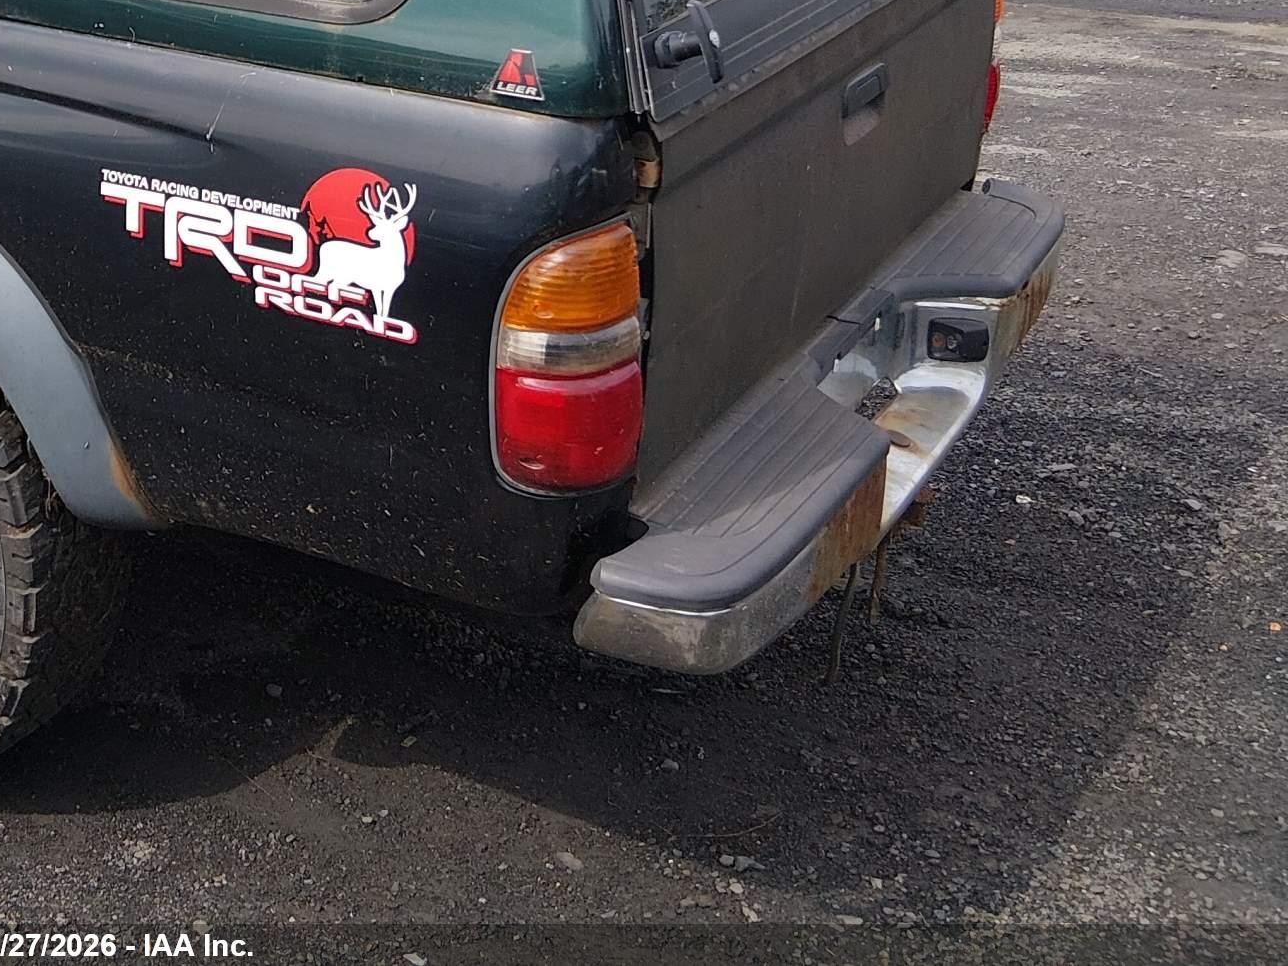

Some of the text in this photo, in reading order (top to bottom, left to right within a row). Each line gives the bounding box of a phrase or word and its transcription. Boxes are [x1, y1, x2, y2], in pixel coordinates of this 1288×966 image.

[496, 81, 538, 96] LEER
[101, 168, 301, 221] TOYOTA RACING DEVELOPMENT
[100, 181, 312, 283] TRD
[252, 264, 370, 306] OFF
[254, 286, 419, 345] ROAD
